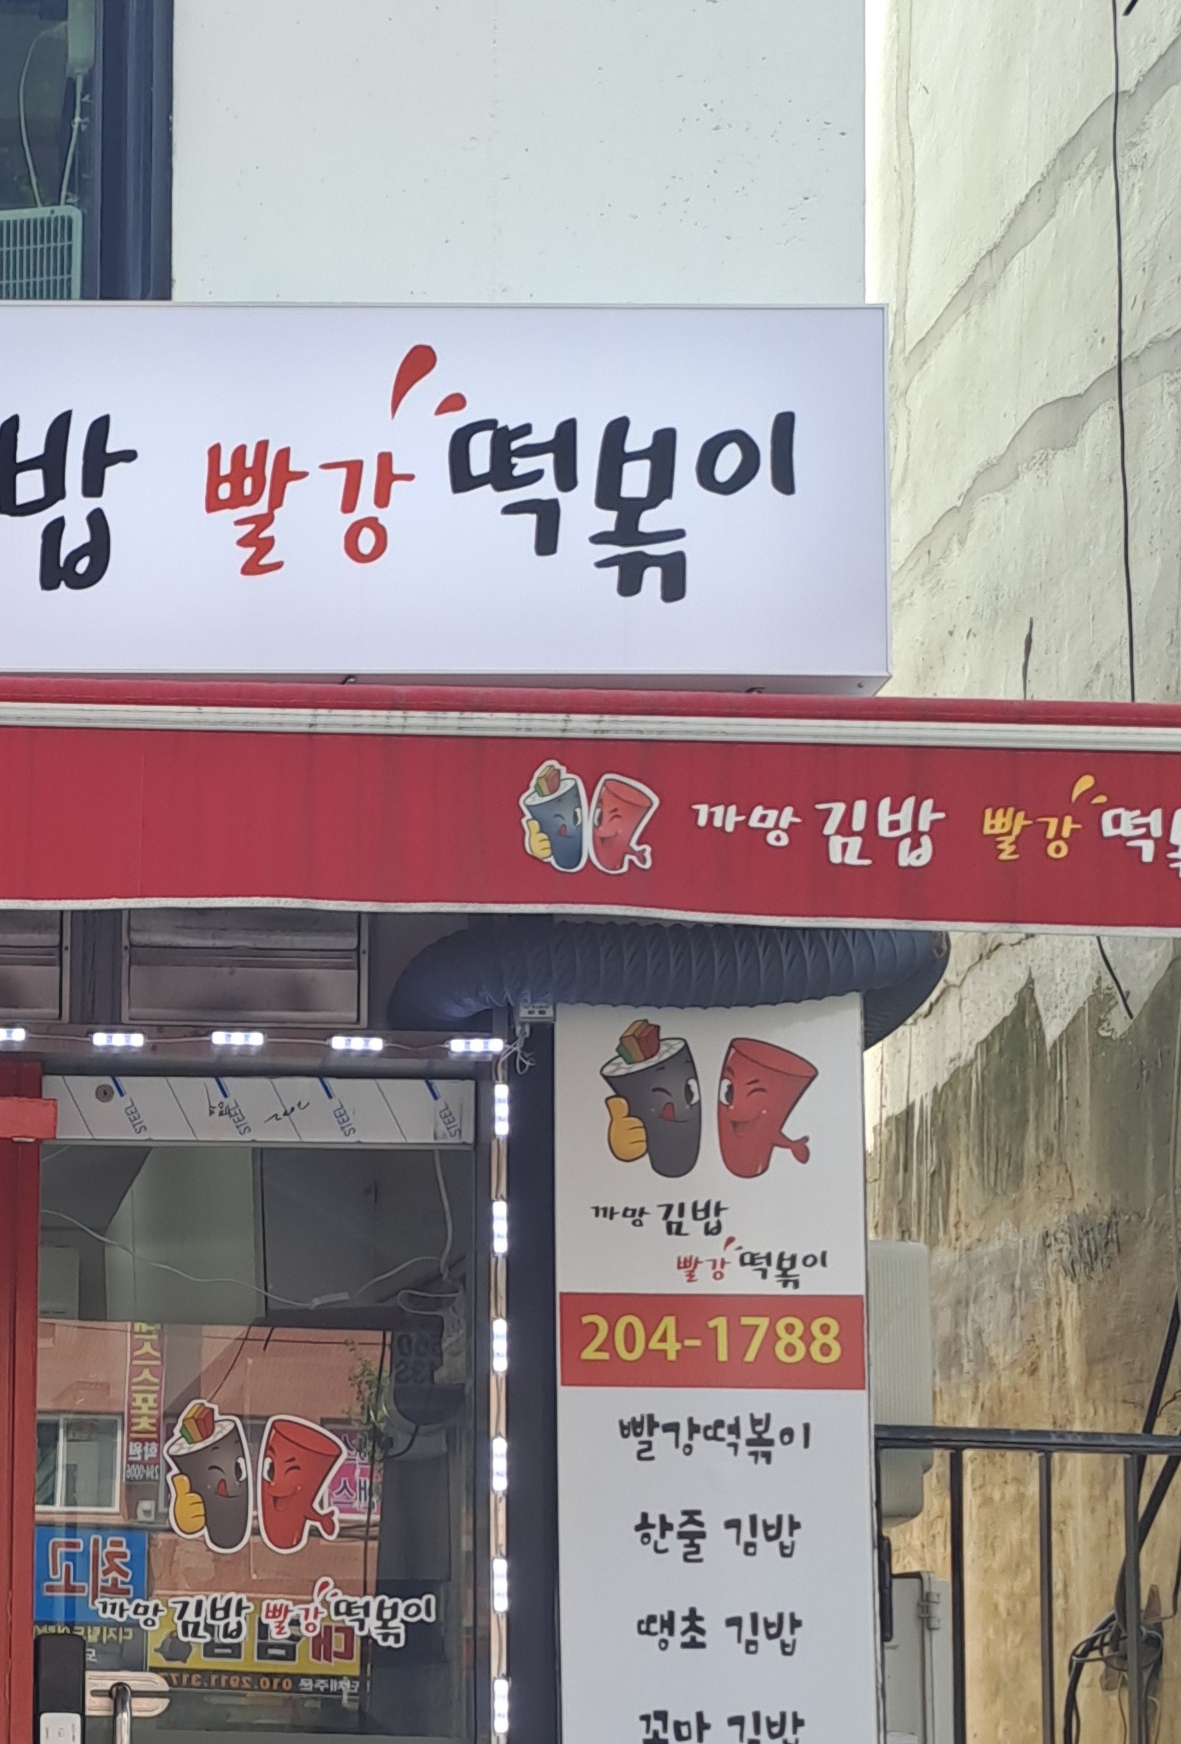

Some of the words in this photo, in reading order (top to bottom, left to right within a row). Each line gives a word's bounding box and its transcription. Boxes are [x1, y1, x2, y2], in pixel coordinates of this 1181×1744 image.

[205, 438, 418, 575] 빨강
[447, 409, 798, 603] 떡볶이
[691, 802, 803, 848] 까망
[814, 795, 946, 867] 김밥
[982, 805, 1083, 862] 빨강
[1100, 806, 1181, 880] 떡
[590, 1204, 651, 1228] 까망
[657, 1200, 729, 1237] 김밥
[676, 1253, 730, 1283] 빨강
[739, 1250, 828, 1289] 떡볶이
[580, 1314, 842, 1364] 204-1788
[618, 1412, 811, 1466] 빨강떡볶이
[634, 1509, 707, 1564] 한줄
[723, 1512, 802, 1558] 김밥
[96, 1598, 165, 1630] 까망
[172, 1596, 252, 1641] 김밥
[263, 1601, 322, 1635] 빨강
[332, 1596, 435, 1647] 떡볶이
[636, 1607, 707, 1652] 땡초
[725, 1611, 803, 1656] 김밥
